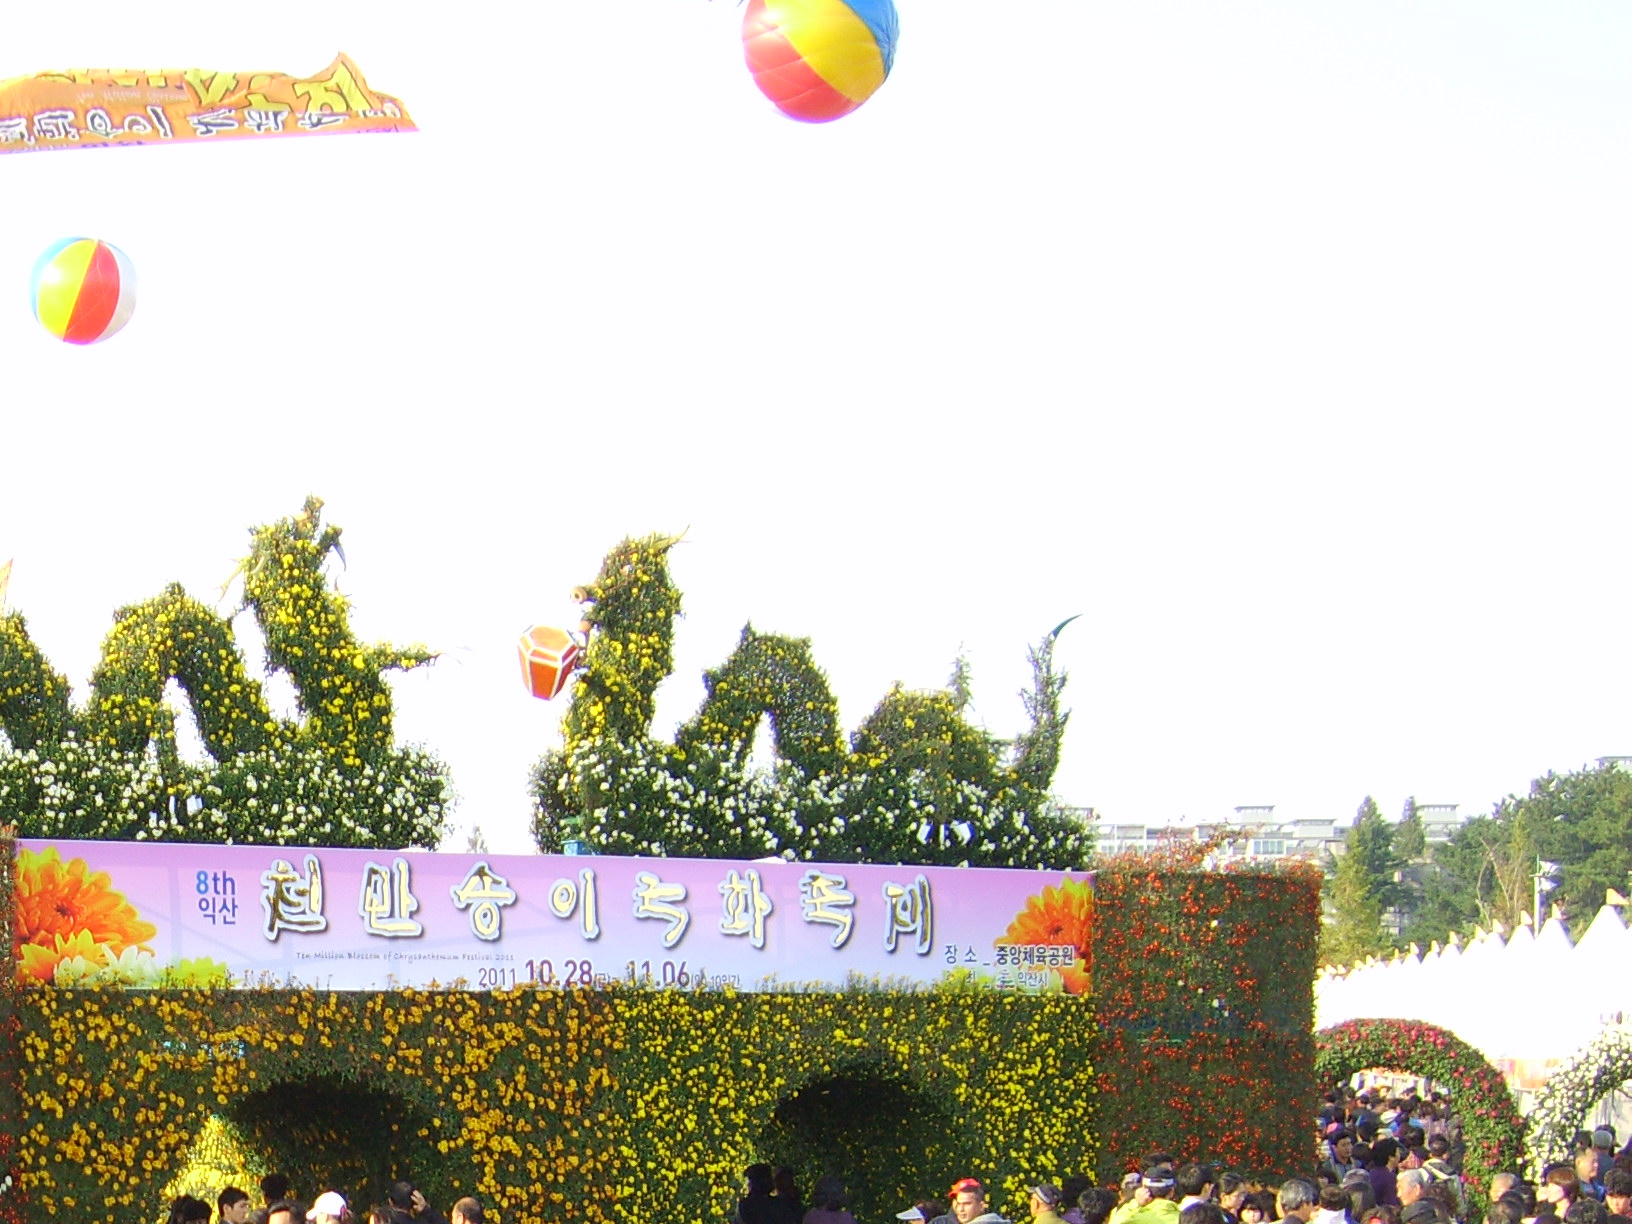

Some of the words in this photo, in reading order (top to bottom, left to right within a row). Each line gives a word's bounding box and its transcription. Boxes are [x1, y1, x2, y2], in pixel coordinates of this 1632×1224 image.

[195, 870, 236, 896] 8th
[198, 896, 238, 925] 익산
[996, 945, 1073, 967] 중앙체육공원
[479, 967, 517, 987] 2011
